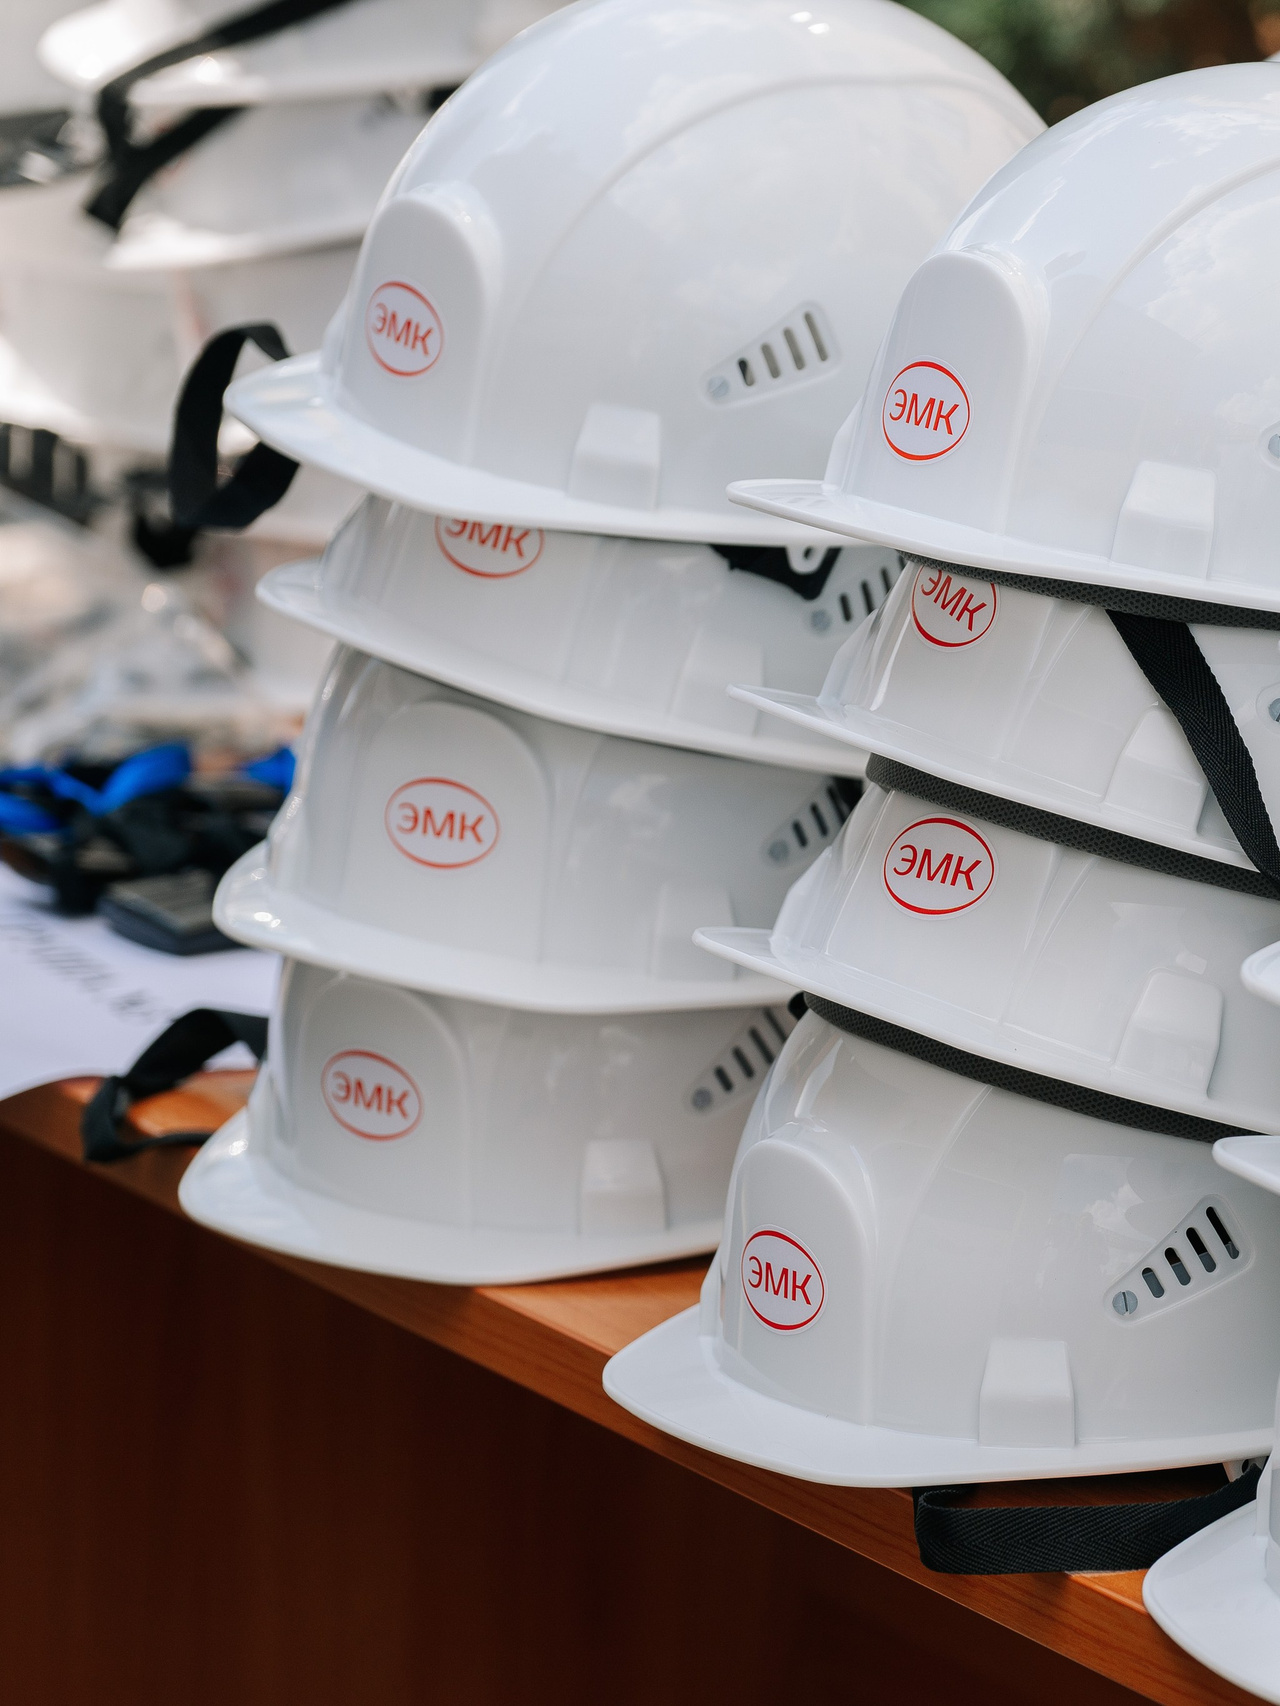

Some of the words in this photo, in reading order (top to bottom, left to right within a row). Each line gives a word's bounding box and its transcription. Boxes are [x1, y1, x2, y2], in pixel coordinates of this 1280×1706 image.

[375, 302, 433, 355] ЭМК
[888, 388, 960, 436] ЭМК
[396, 801, 484, 844] ЭМК
[892, 843, 983, 891] ЭМК
[331, 1070, 410, 1119] ЭМК
[747, 1255, 813, 1306] ЭМК
